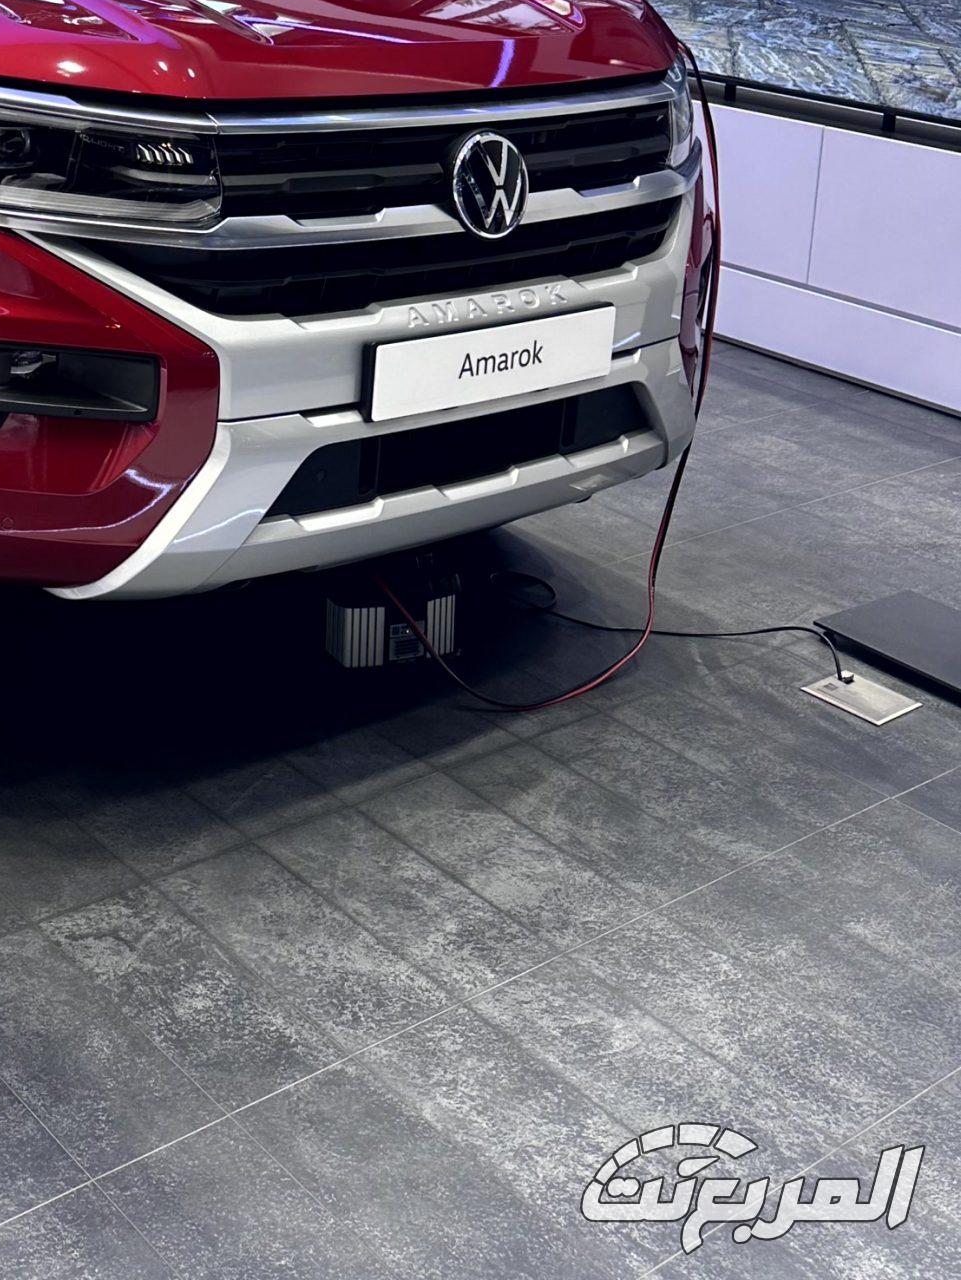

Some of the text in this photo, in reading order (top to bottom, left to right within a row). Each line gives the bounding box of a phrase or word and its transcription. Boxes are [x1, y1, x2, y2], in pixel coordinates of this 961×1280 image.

[453, 131, 529, 239] VW
[408, 284, 568, 328] AMAROK
[458, 340, 543, 379] Amarok
